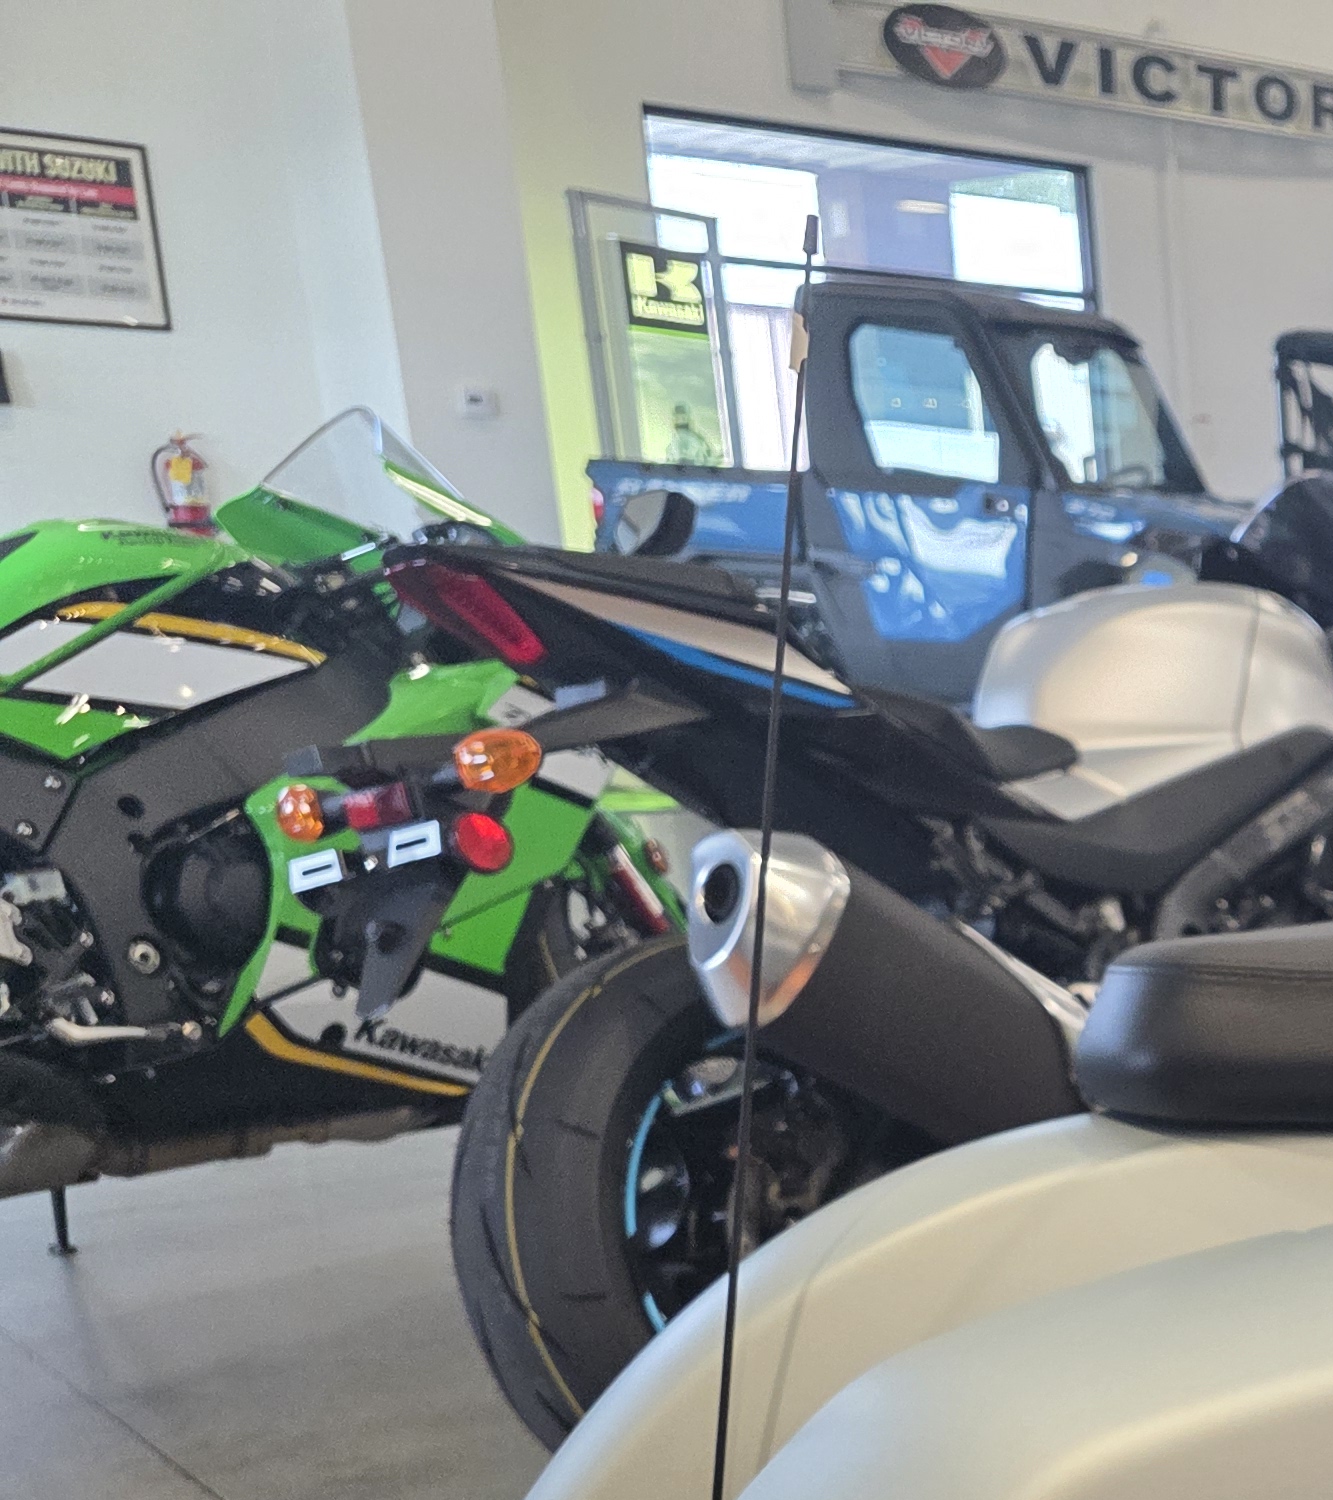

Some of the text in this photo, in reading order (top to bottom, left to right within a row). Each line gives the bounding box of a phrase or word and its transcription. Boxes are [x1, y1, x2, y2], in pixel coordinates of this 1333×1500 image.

[43, 153, 117, 184] SUZUKI
[631, 295, 704, 325] Kawasaki
[354, 1017, 489, 1070] Kawasak
